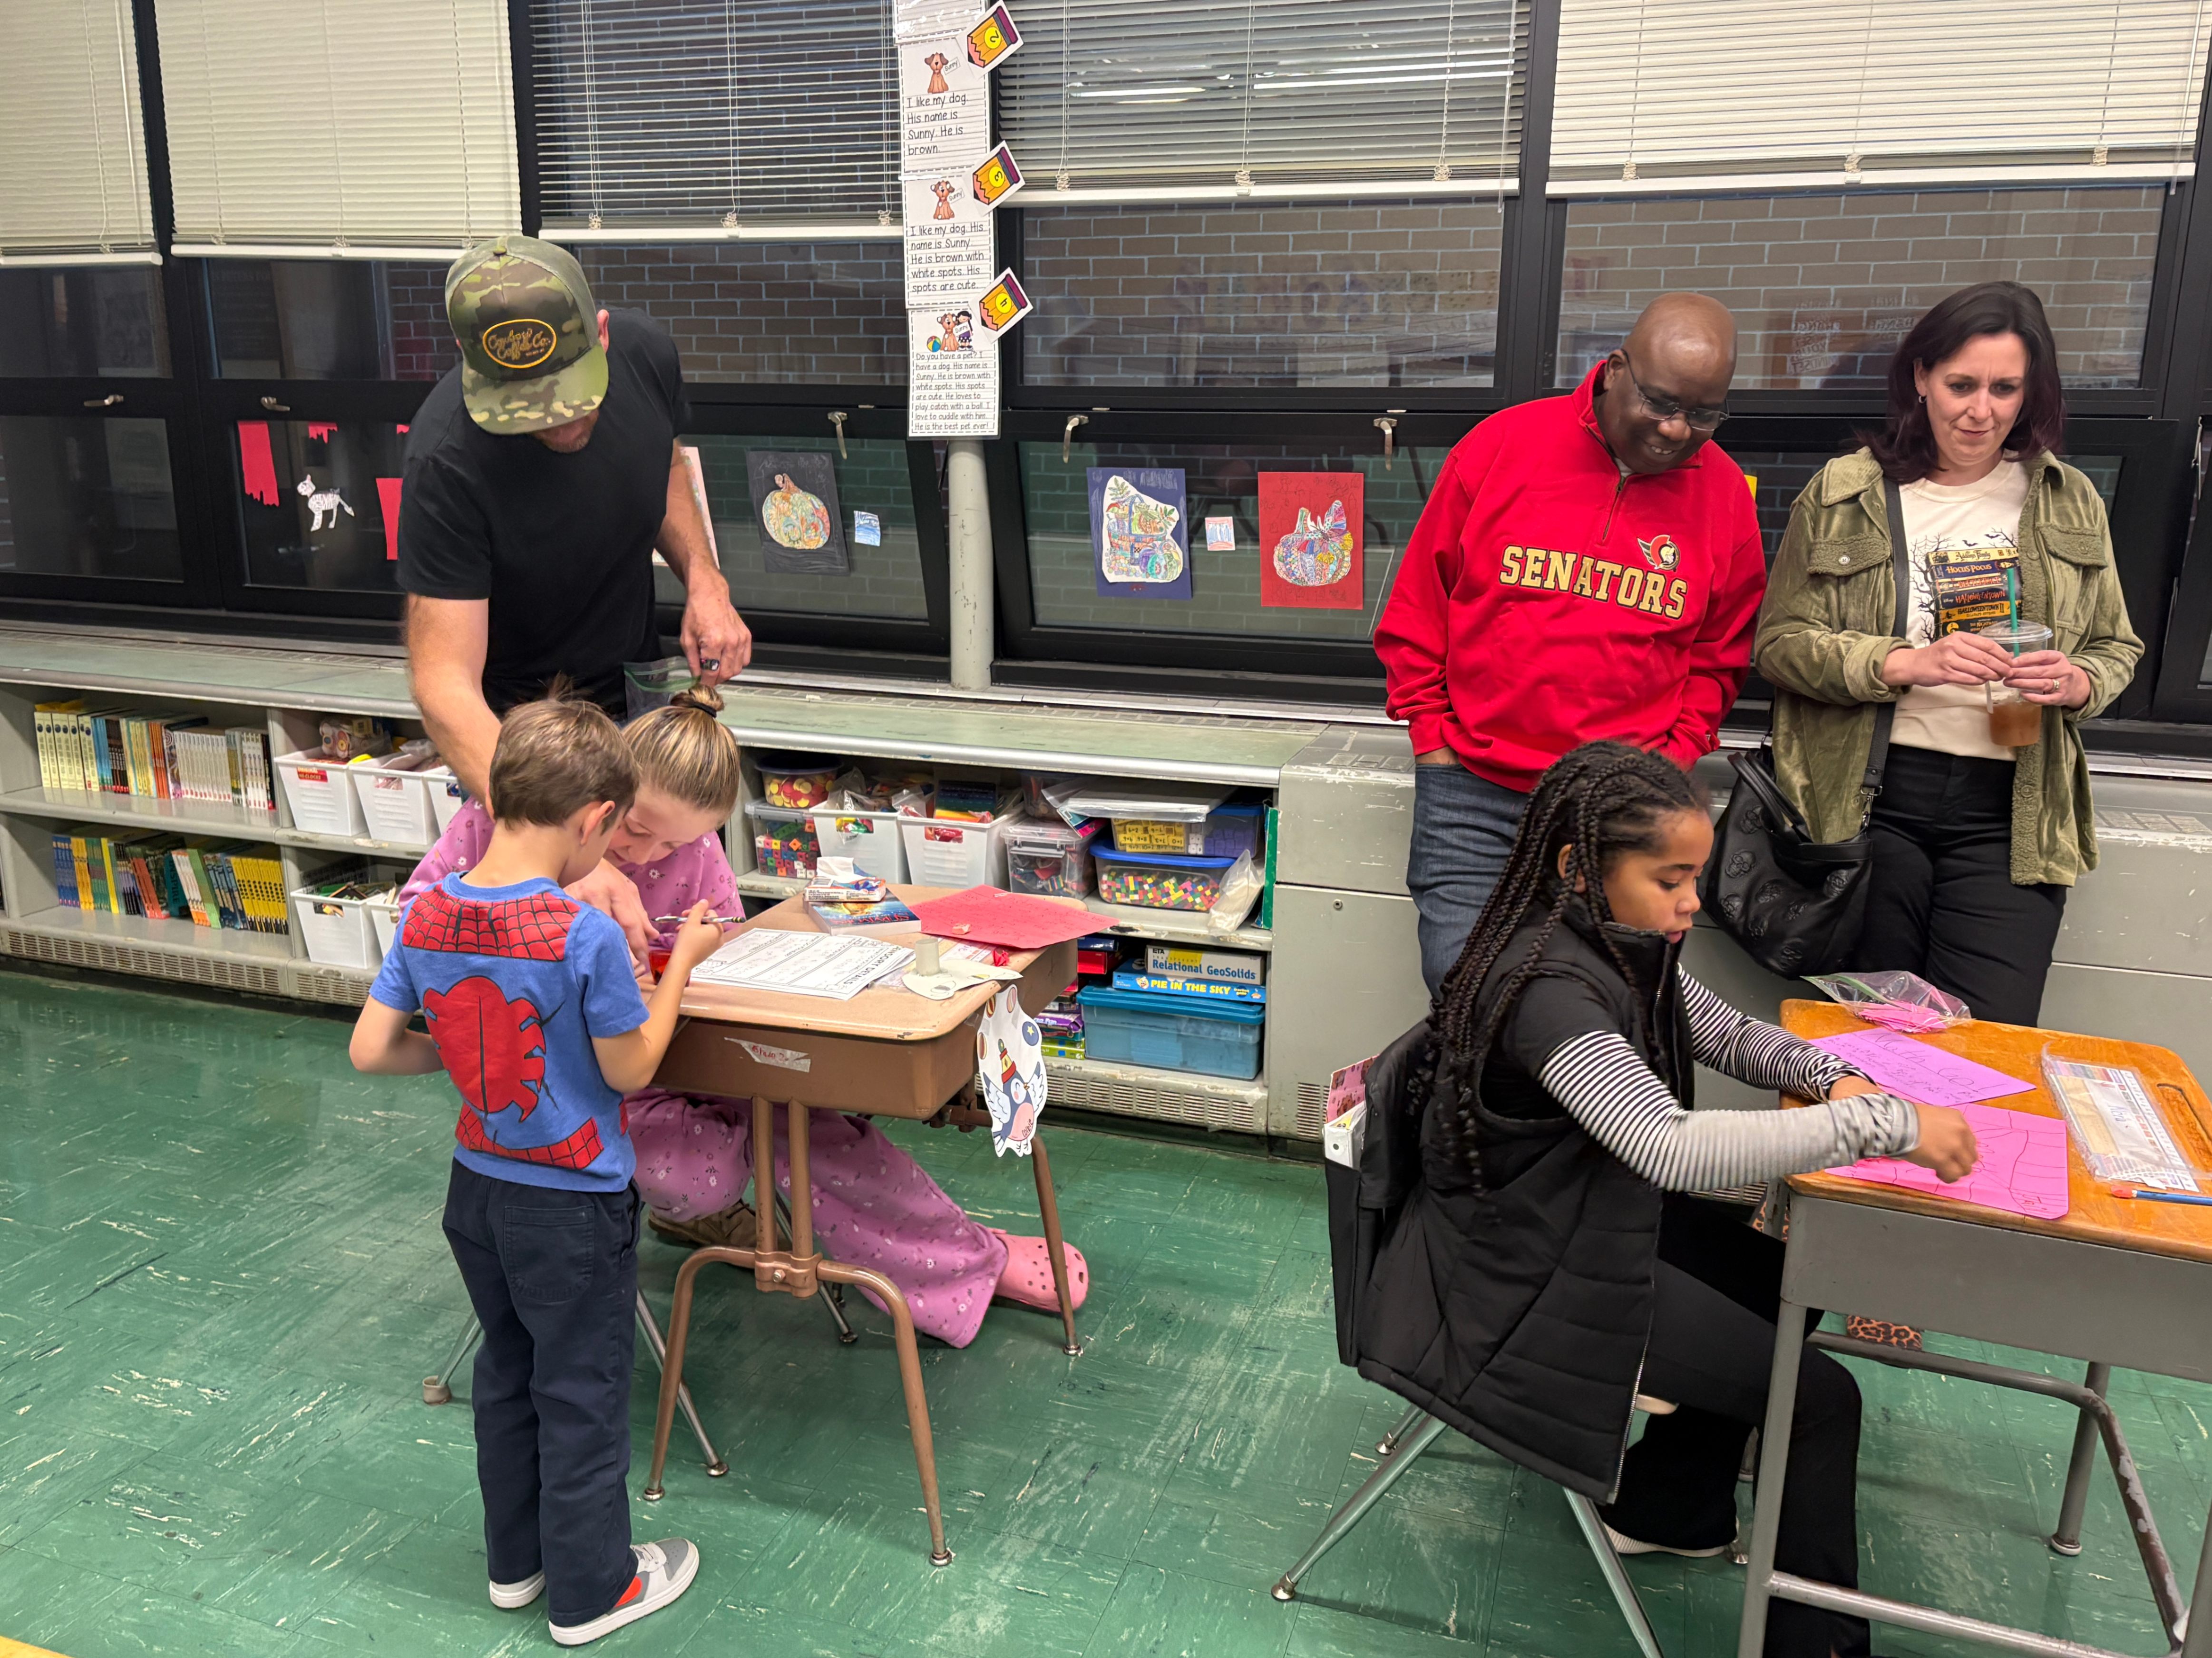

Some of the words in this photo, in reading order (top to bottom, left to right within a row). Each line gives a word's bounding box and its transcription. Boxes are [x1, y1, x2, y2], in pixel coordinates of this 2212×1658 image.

[906, 97, 913, 108] I
[916, 97, 930, 107] like
[933, 95, 945, 108] my
[949, 92, 968, 105] dog.
[907, 112, 921, 124] His
[925, 112, 947, 122] name
[950, 110, 958, 119] is
[908, 128, 937, 141] Sunny.
[941, 125, 953, 137] He
[956, 125, 963, 136] is
[908, 144, 940, 155] brown.
[910, 226, 916, 236] I
[919, 225, 932, 236] like
[935, 225, 946, 237] my
[950, 223, 967, 235] dog.
[970, 222, 984, 232] His
[911, 242, 932, 251] name
[935, 239, 942, 249] is
[945, 238, 973, 250] Sunny.
[911, 254, 923, 264] He
[926, 254, 933, 263] is
[935, 252, 963, 263] brown
[965, 251, 984, 261] with
[911, 268, 935, 278] white
[938, 266, 965, 279] spots.
[967, 265, 981, 275] His
[912, 281, 936, 294] spots
[940, 282, 955, 291] are
[957, 280, 978, 290] cute.
[927, 353, 938, 362] you
[963, 351, 977, 360] pet?
[967, 382, 985, 390] spots
[915, 403, 928, 412] play
[960, 422, 970, 430] pet
[1499, 544, 1688, 620] SENATORS
[1955, 590, 2005, 604] HALLOWEENTOWN
[844, 967, 875, 985] DETAILS
[1152, 960, 1202, 974] Relational
[1207, 965, 1256, 979] GeoSolids
[1151, 979, 1167, 989] PIE
[1170, 981, 1183, 989] IN
[1185, 982, 1207, 992] THE
[1209, 985, 1231, 995] SKY
[1855, 1032, 1932, 1064] Math
